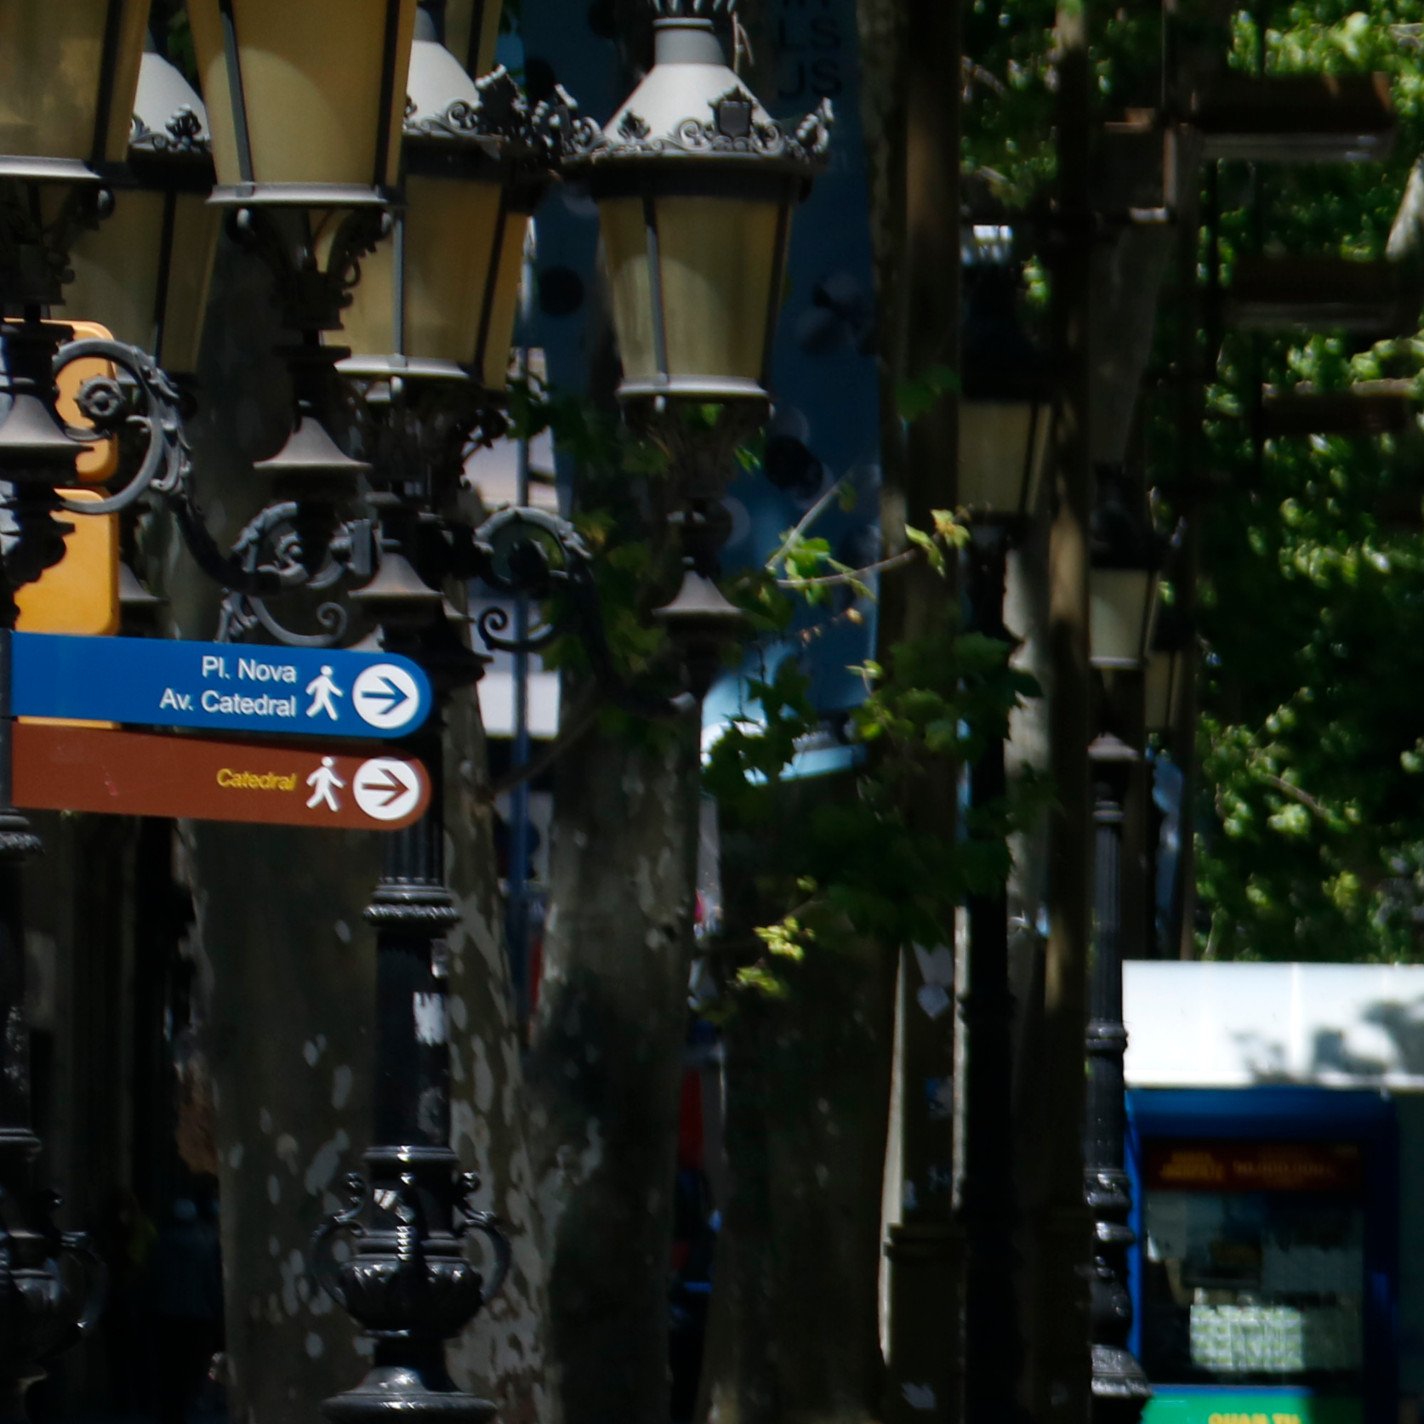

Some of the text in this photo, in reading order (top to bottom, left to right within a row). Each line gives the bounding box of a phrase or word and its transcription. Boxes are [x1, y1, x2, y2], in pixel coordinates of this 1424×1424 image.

[201, 655, 297, 684] Pl. Nova
[160, 688, 297, 718] Av. Catedral
[216, 767, 298, 791] Catedral
